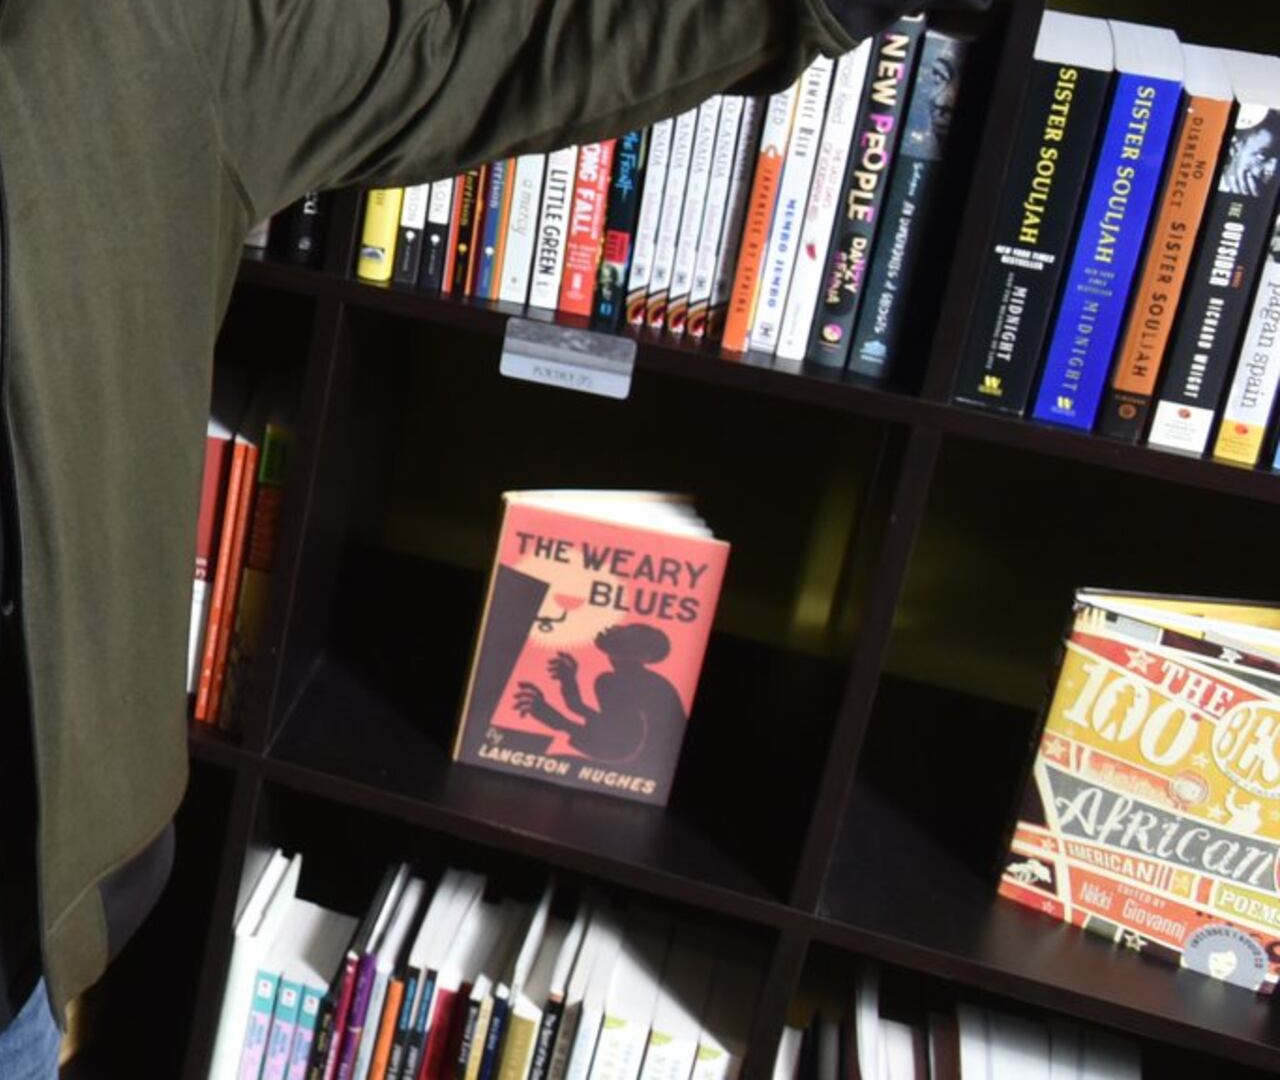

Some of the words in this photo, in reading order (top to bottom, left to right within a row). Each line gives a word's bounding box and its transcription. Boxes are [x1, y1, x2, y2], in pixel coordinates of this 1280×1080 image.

[872, 32, 910, 105] NEW
[1043, 66, 1079, 143] SISTER
[1124, 84, 1157, 160] SISTER
[847, 112, 896, 223] PEOPLE
[1170, 116, 1204, 209] DISRESPECT
[1193, 160, 1206, 182] NO
[543, 168, 569, 224] LITTLE
[1018, 146, 1059, 245] SOULJAH
[1093, 165, 1135, 265] SOULJAH
[1228, 202, 1243, 220] THE
[537, 225, 561, 276] GREEN
[843, 237, 867, 295] DANZY
[1157, 221, 1187, 287] SISTER
[1209, 221, 1245, 289] OUTSIDER
[996, 284, 1029, 363] MIDNIGHT
[1132, 293, 1168, 379] SOULJAH
[1198, 297, 1225, 351] RICHARD
[1183, 354, 1209, 400] WRIGHT
[1241, 352, 1269, 410] spain
[515, 531, 574, 565] THE
[581, 542, 710, 589] WEARY
[588, 579, 701, 623] BLUES
[1063, 662, 1201, 769] 100
[1159, 662, 1235, 720] THE
[485, 726, 505, 745] By
[477, 742, 571, 777] LANGSTON
[577, 766, 658, 795] HUGHES
[1067, 840, 1156, 885] AMERICAN
[1080, 880, 1113, 913] Nikki
[1122, 896, 1188, 945] Giovanni
